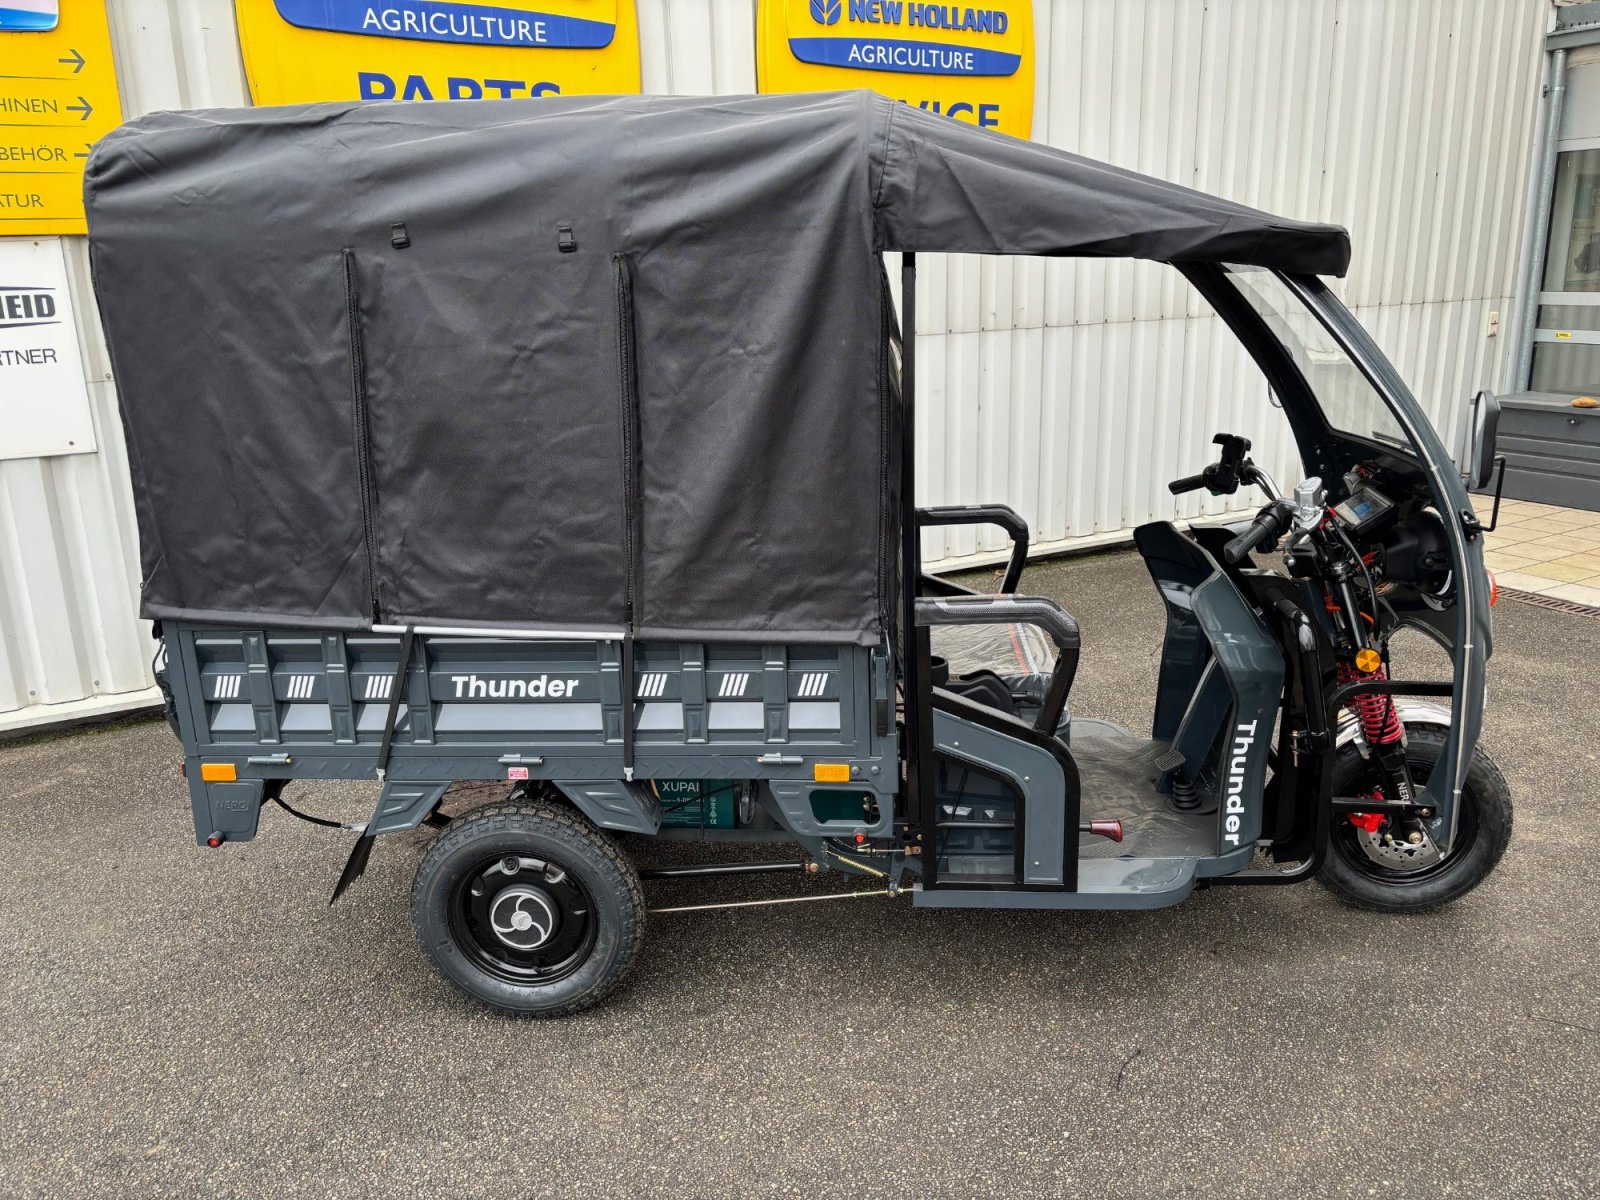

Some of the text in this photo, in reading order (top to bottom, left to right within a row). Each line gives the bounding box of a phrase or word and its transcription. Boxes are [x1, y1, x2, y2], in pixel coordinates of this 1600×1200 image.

[362, 7, 547, 42] AGRICULTURE
[849, 0, 1008, 34] NEW HOLLAND
[848, 44, 974, 70] AGRICULTURE
[0, 194, 44, 208] TUR
[0, 348, 57, 366] TNER
[451, 675, 579, 698] Thunder
[662, 782, 700, 793] XUPAI
[1225, 719, 1258, 846] Thunder
